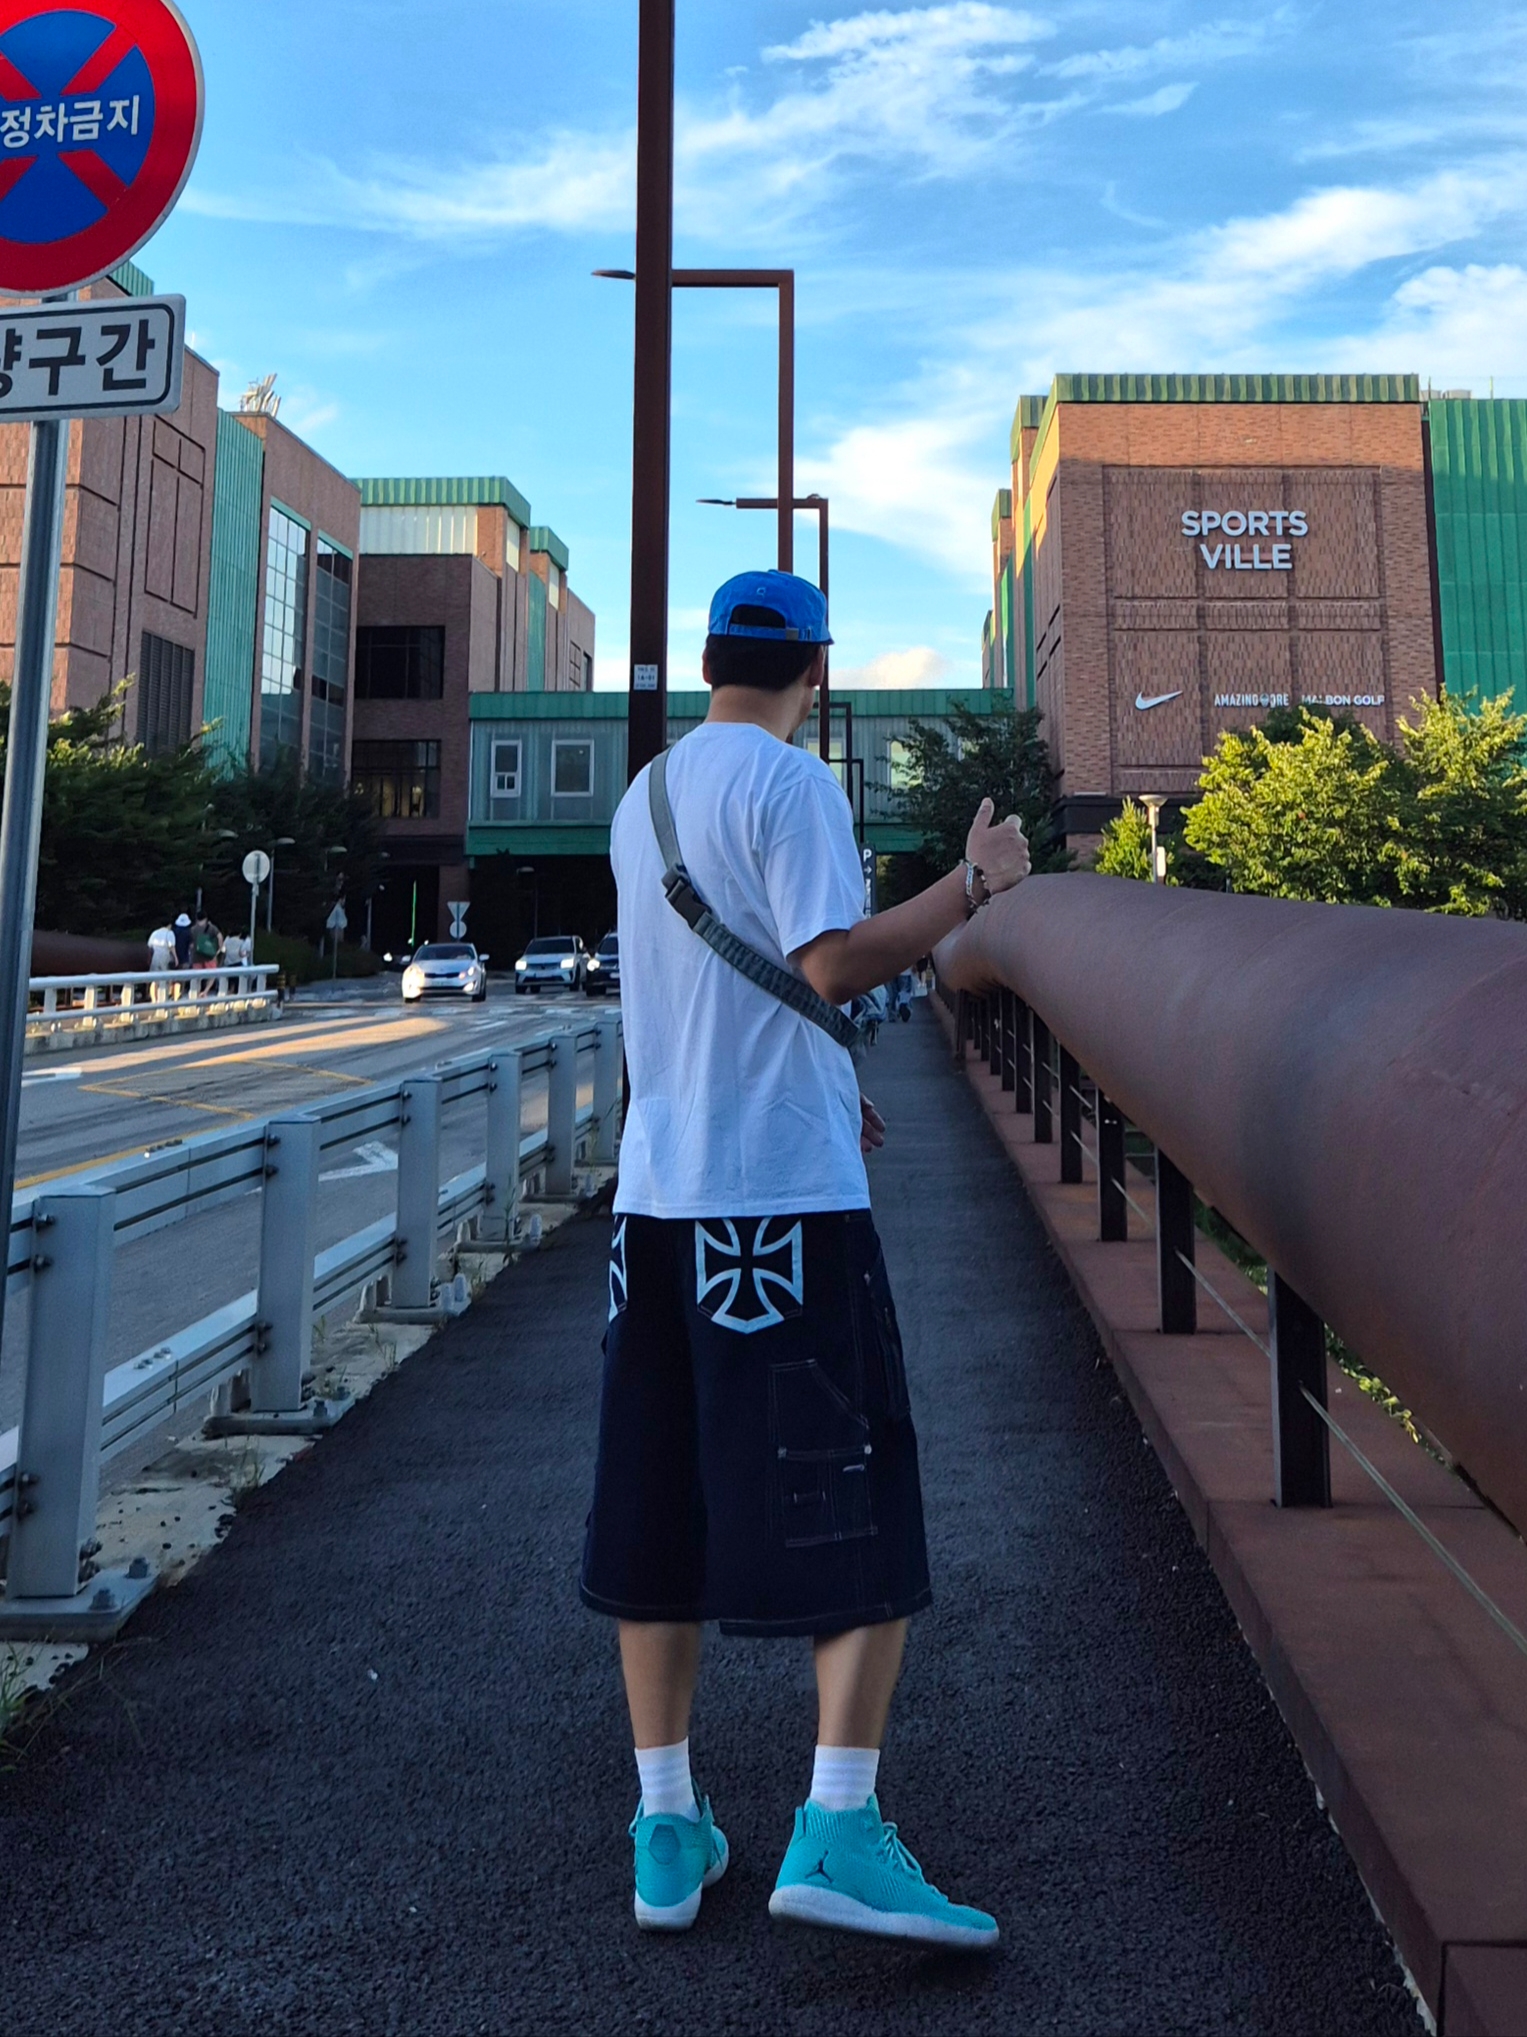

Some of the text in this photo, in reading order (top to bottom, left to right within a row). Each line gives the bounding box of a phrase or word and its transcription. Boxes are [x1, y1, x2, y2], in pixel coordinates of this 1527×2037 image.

[0, 95, 140, 148] 정차금지
[1181, 510, 1309, 536] SPORTS
[1200, 543, 1293, 569] VILLE
[1353, 694, 1385, 706] GOLF
[863, 848, 872, 862] P
